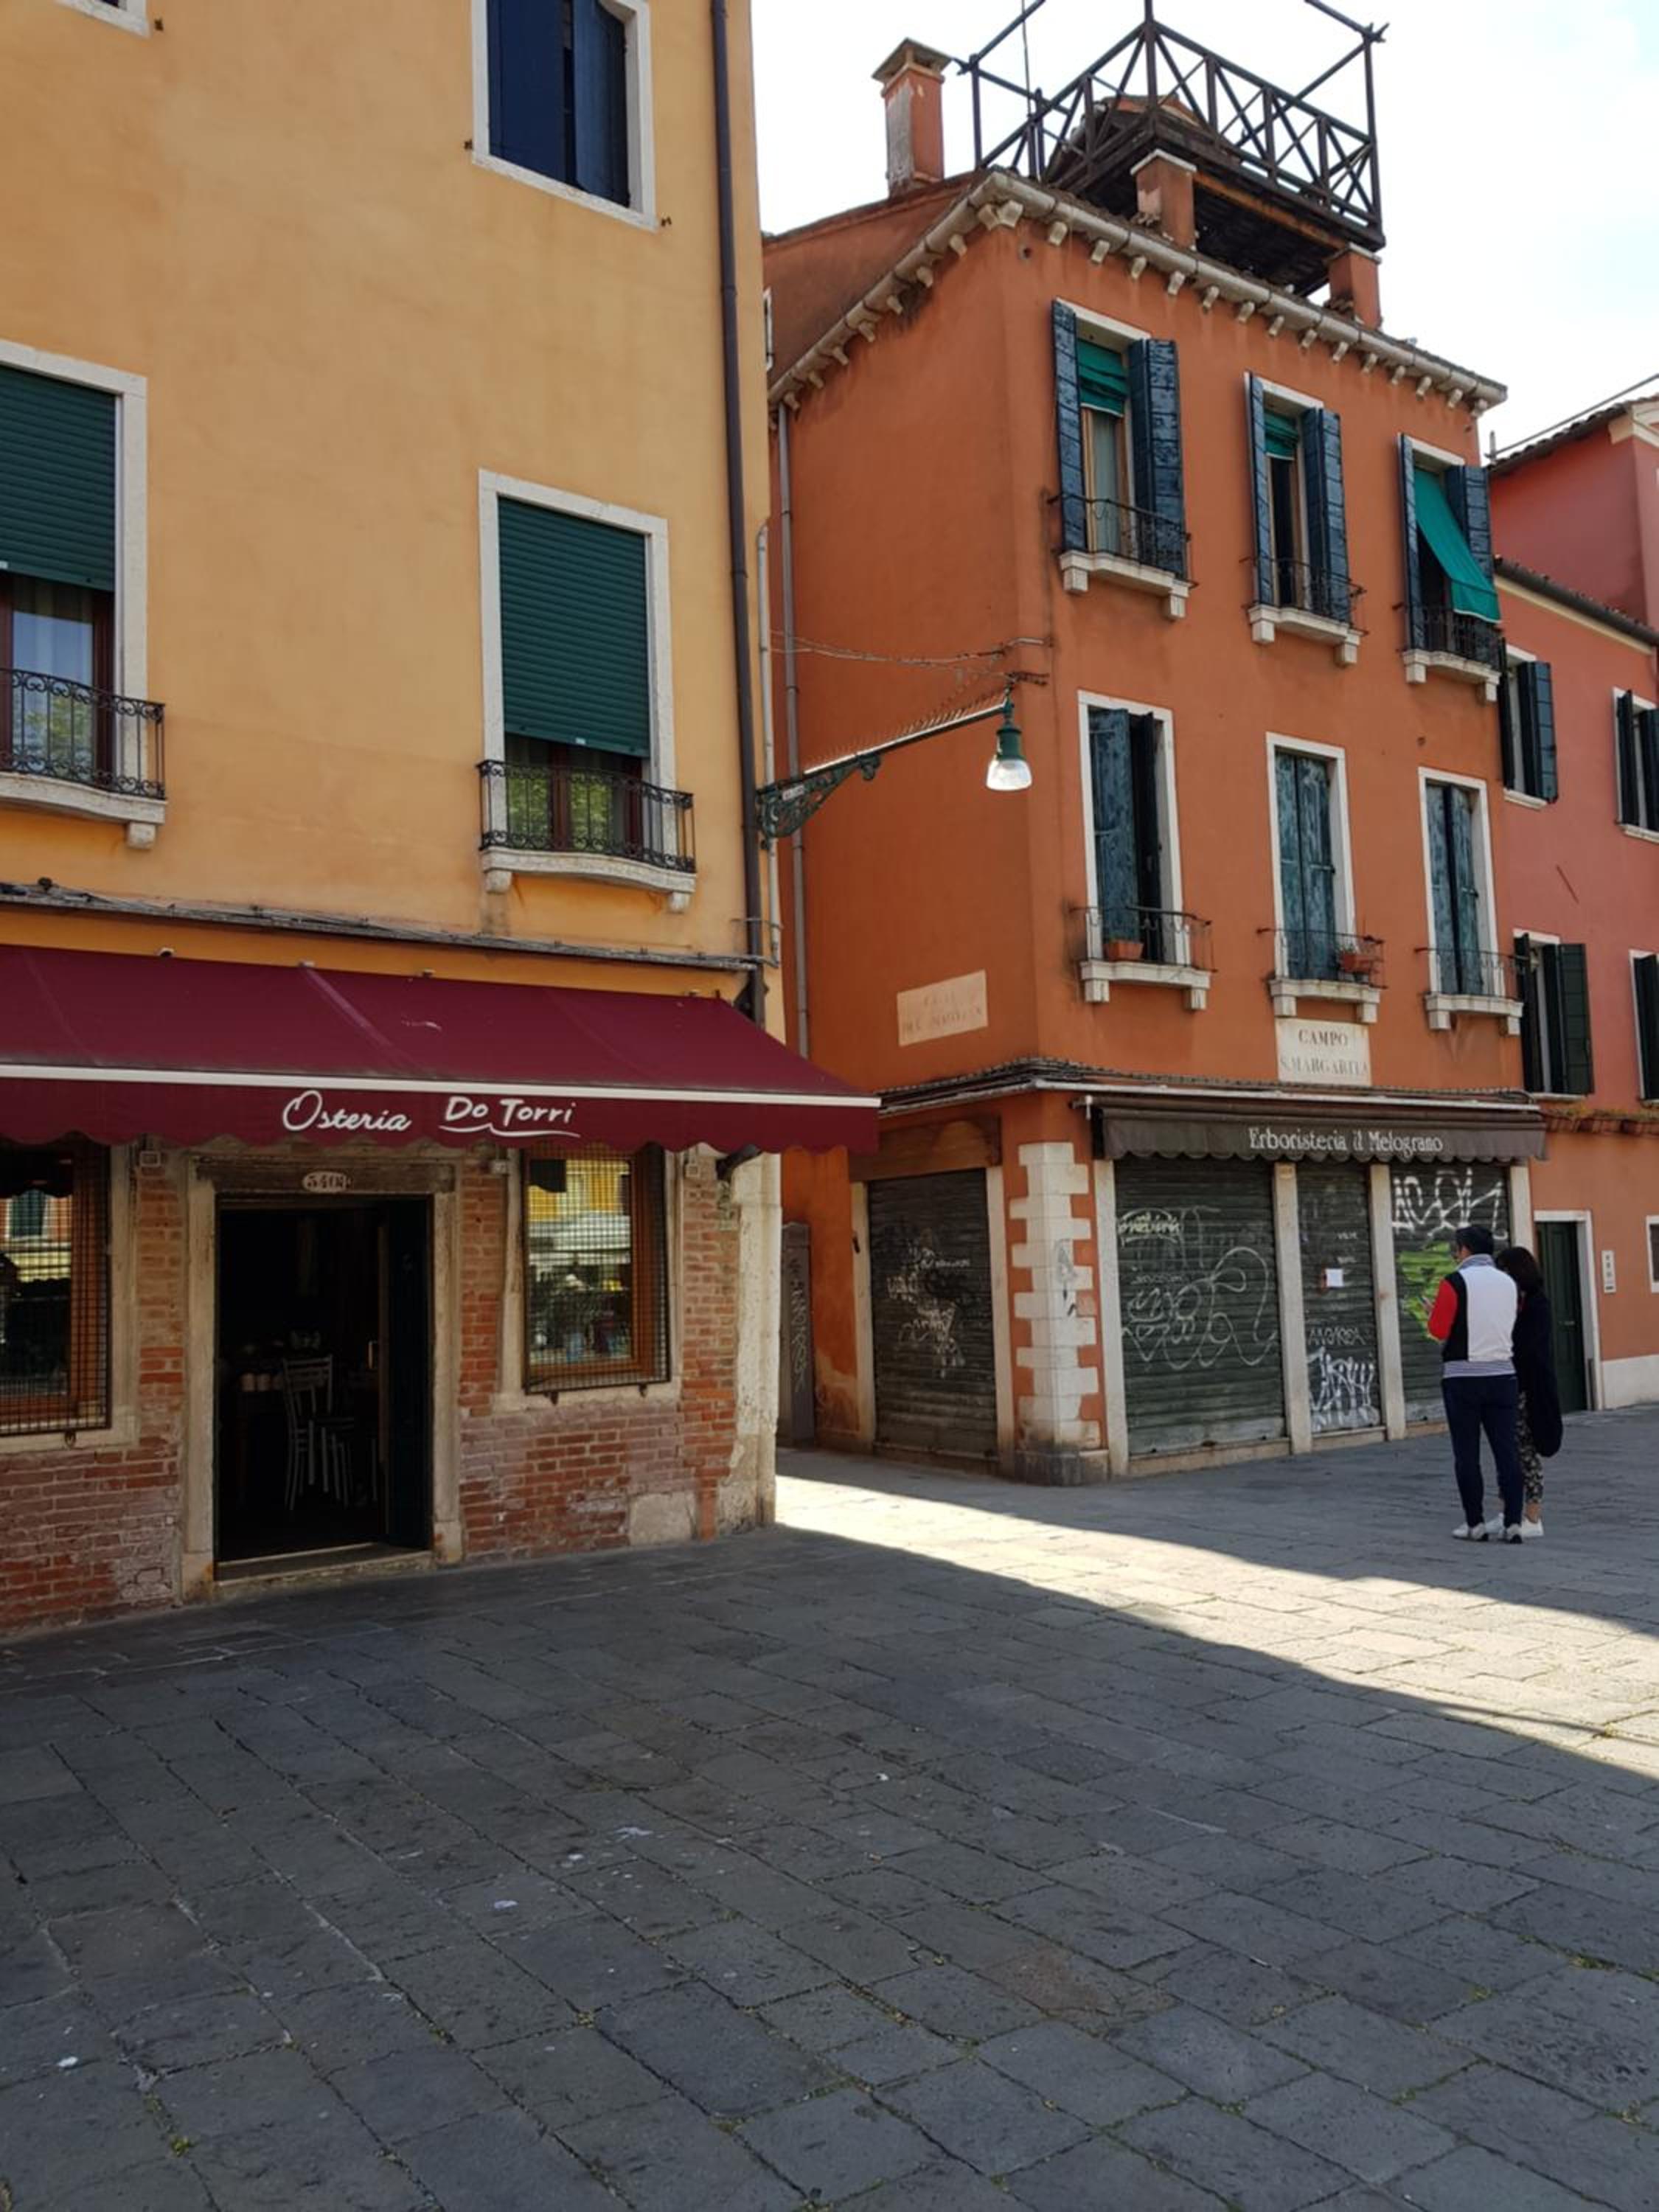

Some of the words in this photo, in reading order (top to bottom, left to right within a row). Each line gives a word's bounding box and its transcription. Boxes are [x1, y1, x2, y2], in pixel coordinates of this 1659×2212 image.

[1298, 1029, 1349, 1047] CAMPO
[282, 1090, 411, 1131] Osteria
[445, 1096, 489, 1122] Do
[499, 1099, 577, 1127] Torri
[1248, 1127, 1347, 1151] Erboristeria
[1368, 1129, 1444, 1158] Melograno
